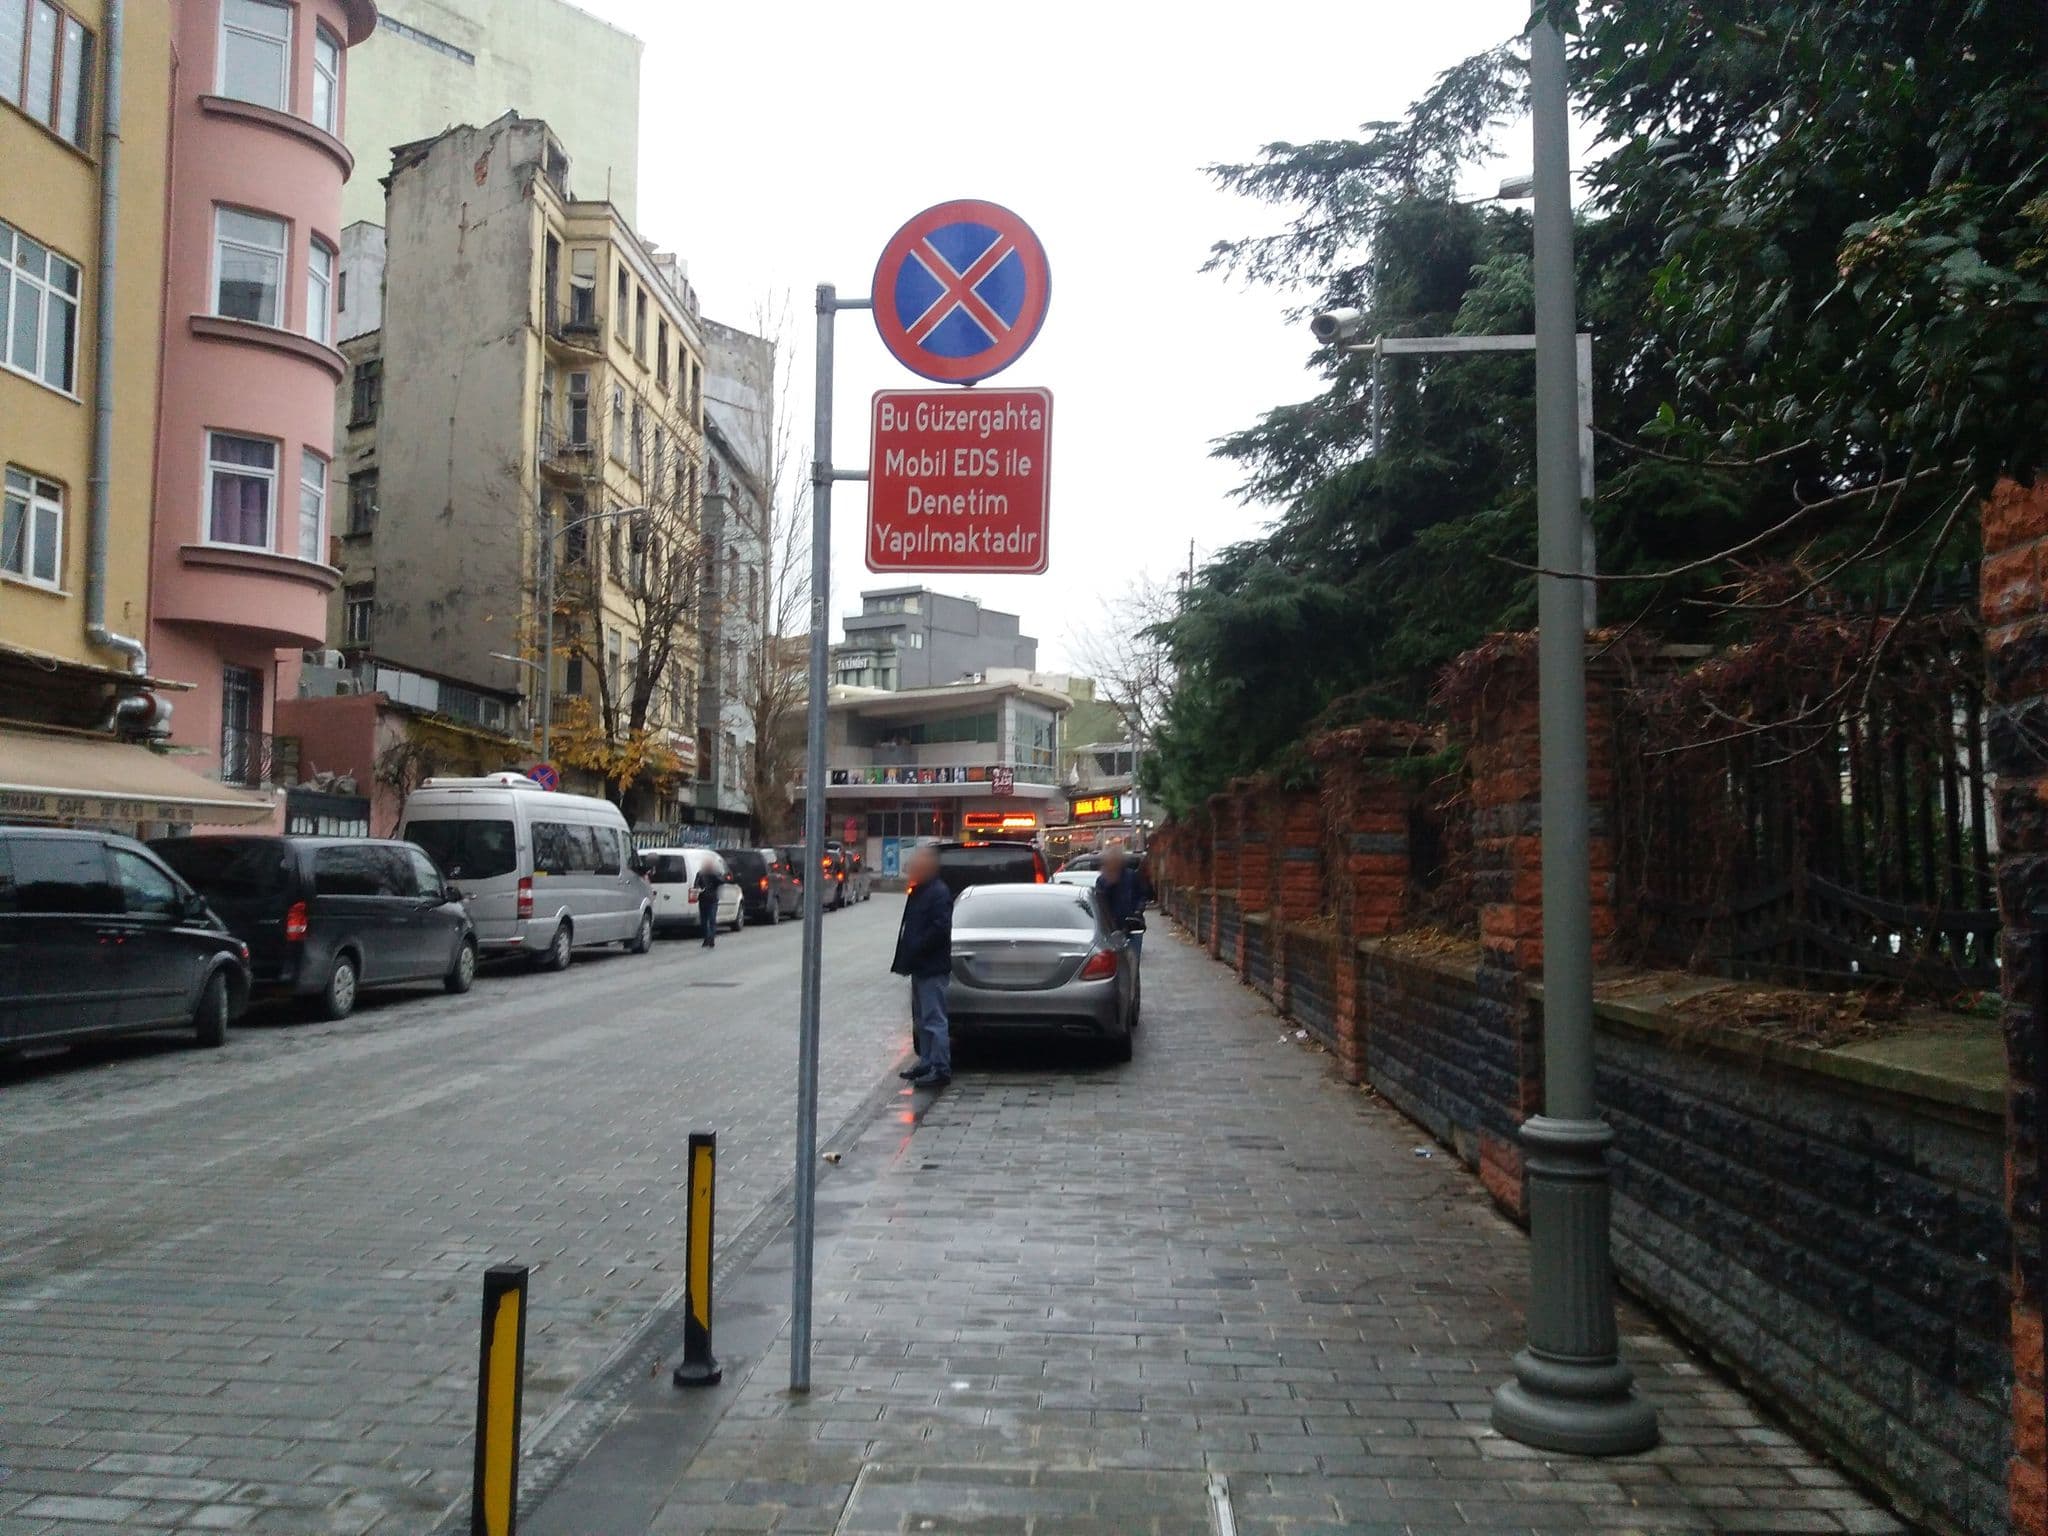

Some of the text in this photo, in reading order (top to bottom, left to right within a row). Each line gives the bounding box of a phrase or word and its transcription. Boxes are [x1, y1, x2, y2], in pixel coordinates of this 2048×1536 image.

[881, 401, 1042, 439] Bu Güzergahta
[885, 448, 1032, 477] Mobil EDS ile
[907, 486, 1008, 515] Denetim
[875, 523, 1038, 561] Yapılmaktadır
